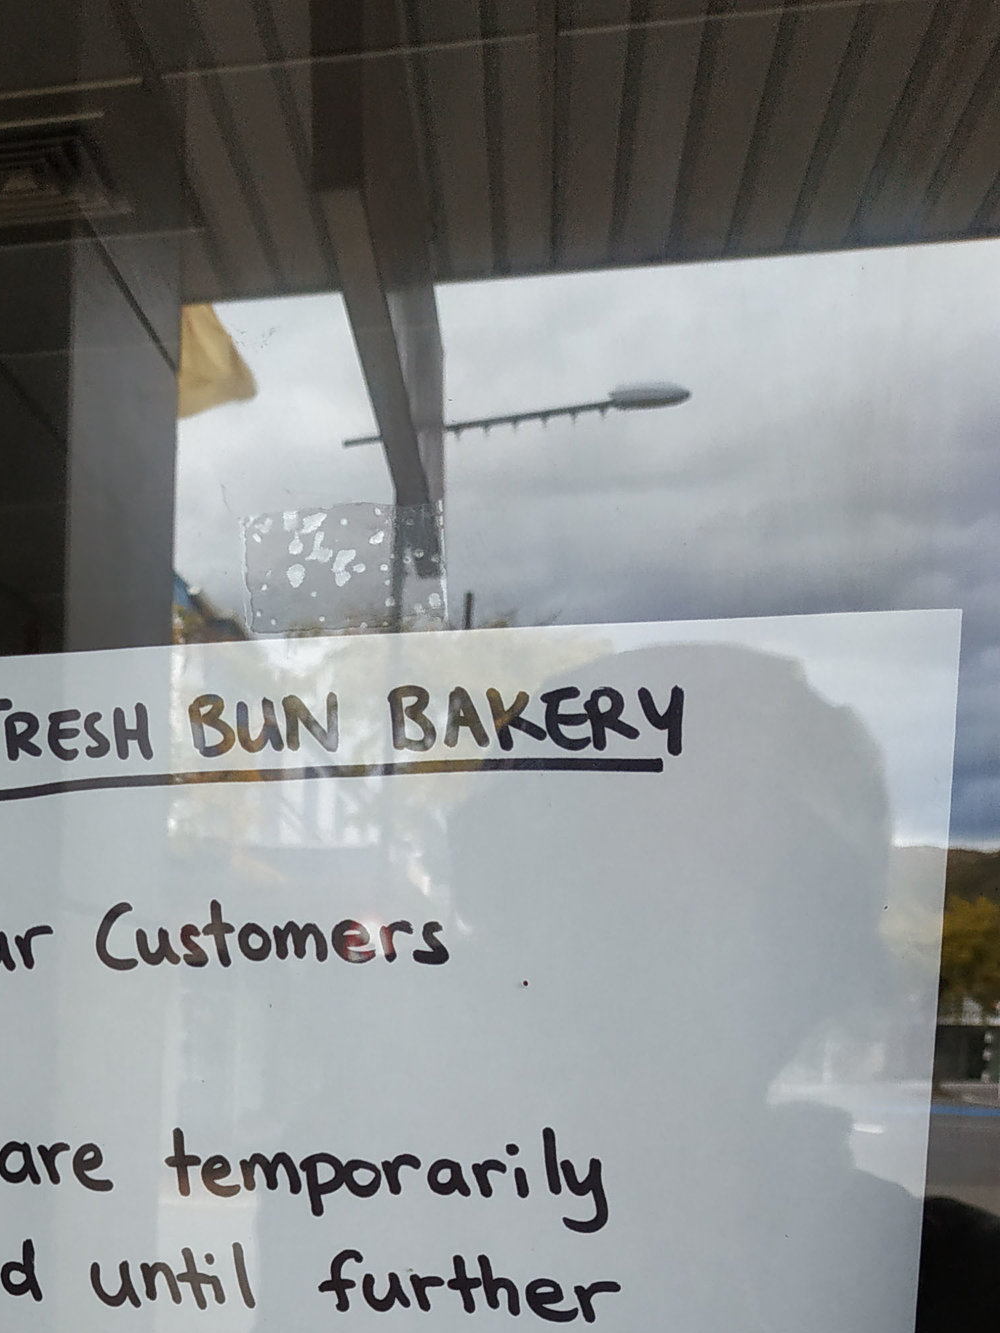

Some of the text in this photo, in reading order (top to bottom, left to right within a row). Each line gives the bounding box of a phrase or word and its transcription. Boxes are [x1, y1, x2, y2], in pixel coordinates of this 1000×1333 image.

[188, 692, 339, 758] BUN
[387, 684, 685, 755] BAKERY
[95, 899, 451, 971] Customers
[164, 1126, 609, 1234] temporarily
[89, 1242, 257, 1310] until
[317, 1248, 622, 1324] further
